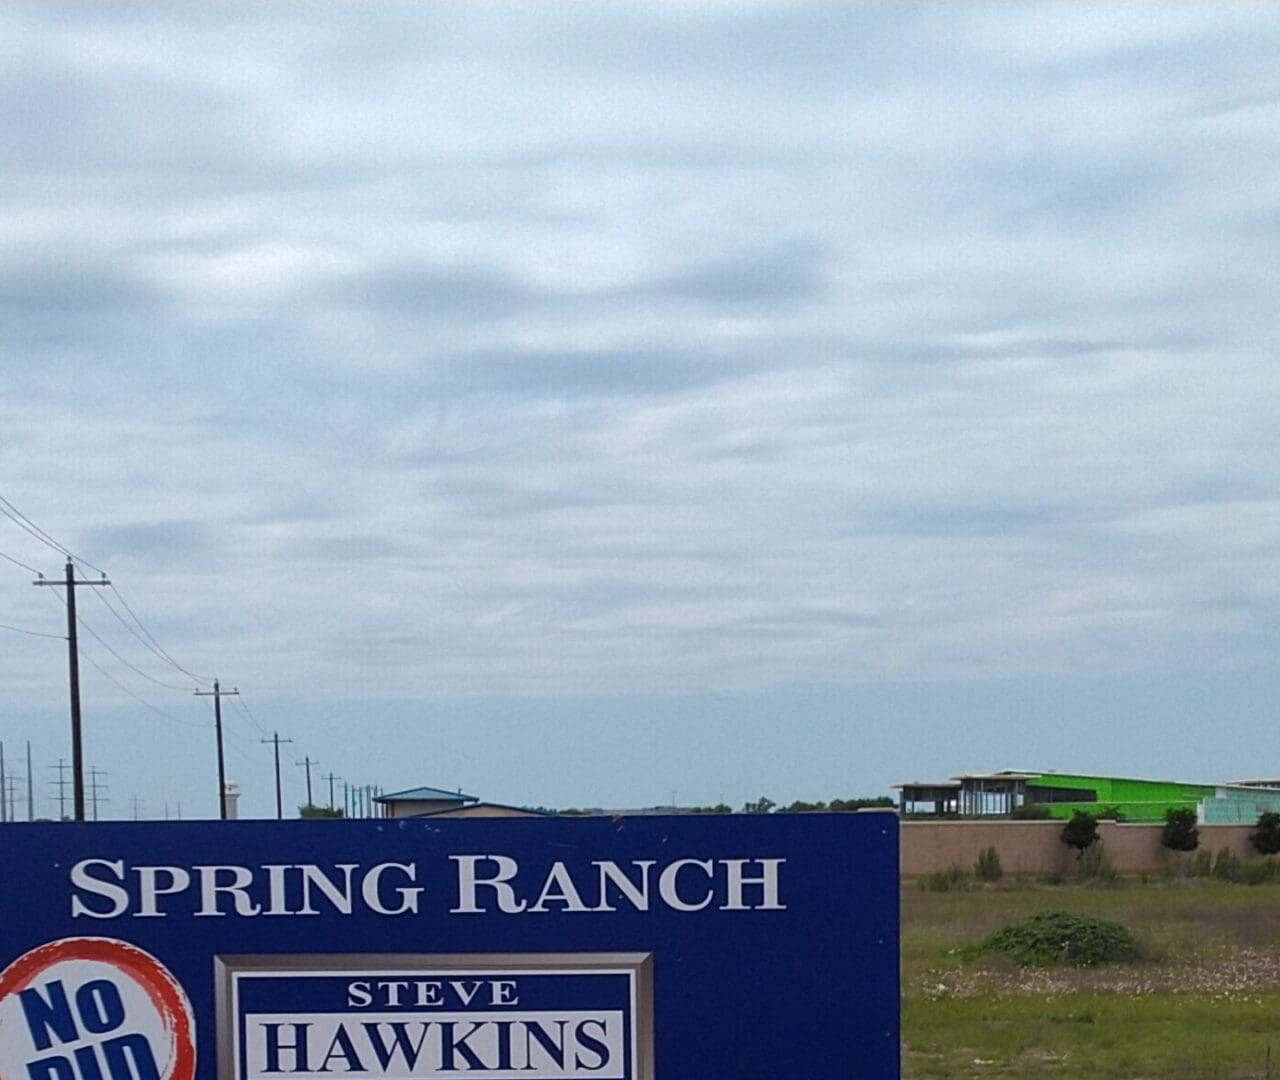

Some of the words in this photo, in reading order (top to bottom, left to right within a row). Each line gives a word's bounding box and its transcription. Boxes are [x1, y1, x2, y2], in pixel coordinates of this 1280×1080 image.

[70, 858, 425, 919] SPRING
[448, 855, 787, 914] RANCH
[19, 979, 125, 1051] NO
[347, 980, 519, 1008] STEVE
[259, 1019, 614, 1074] HAWKINS
